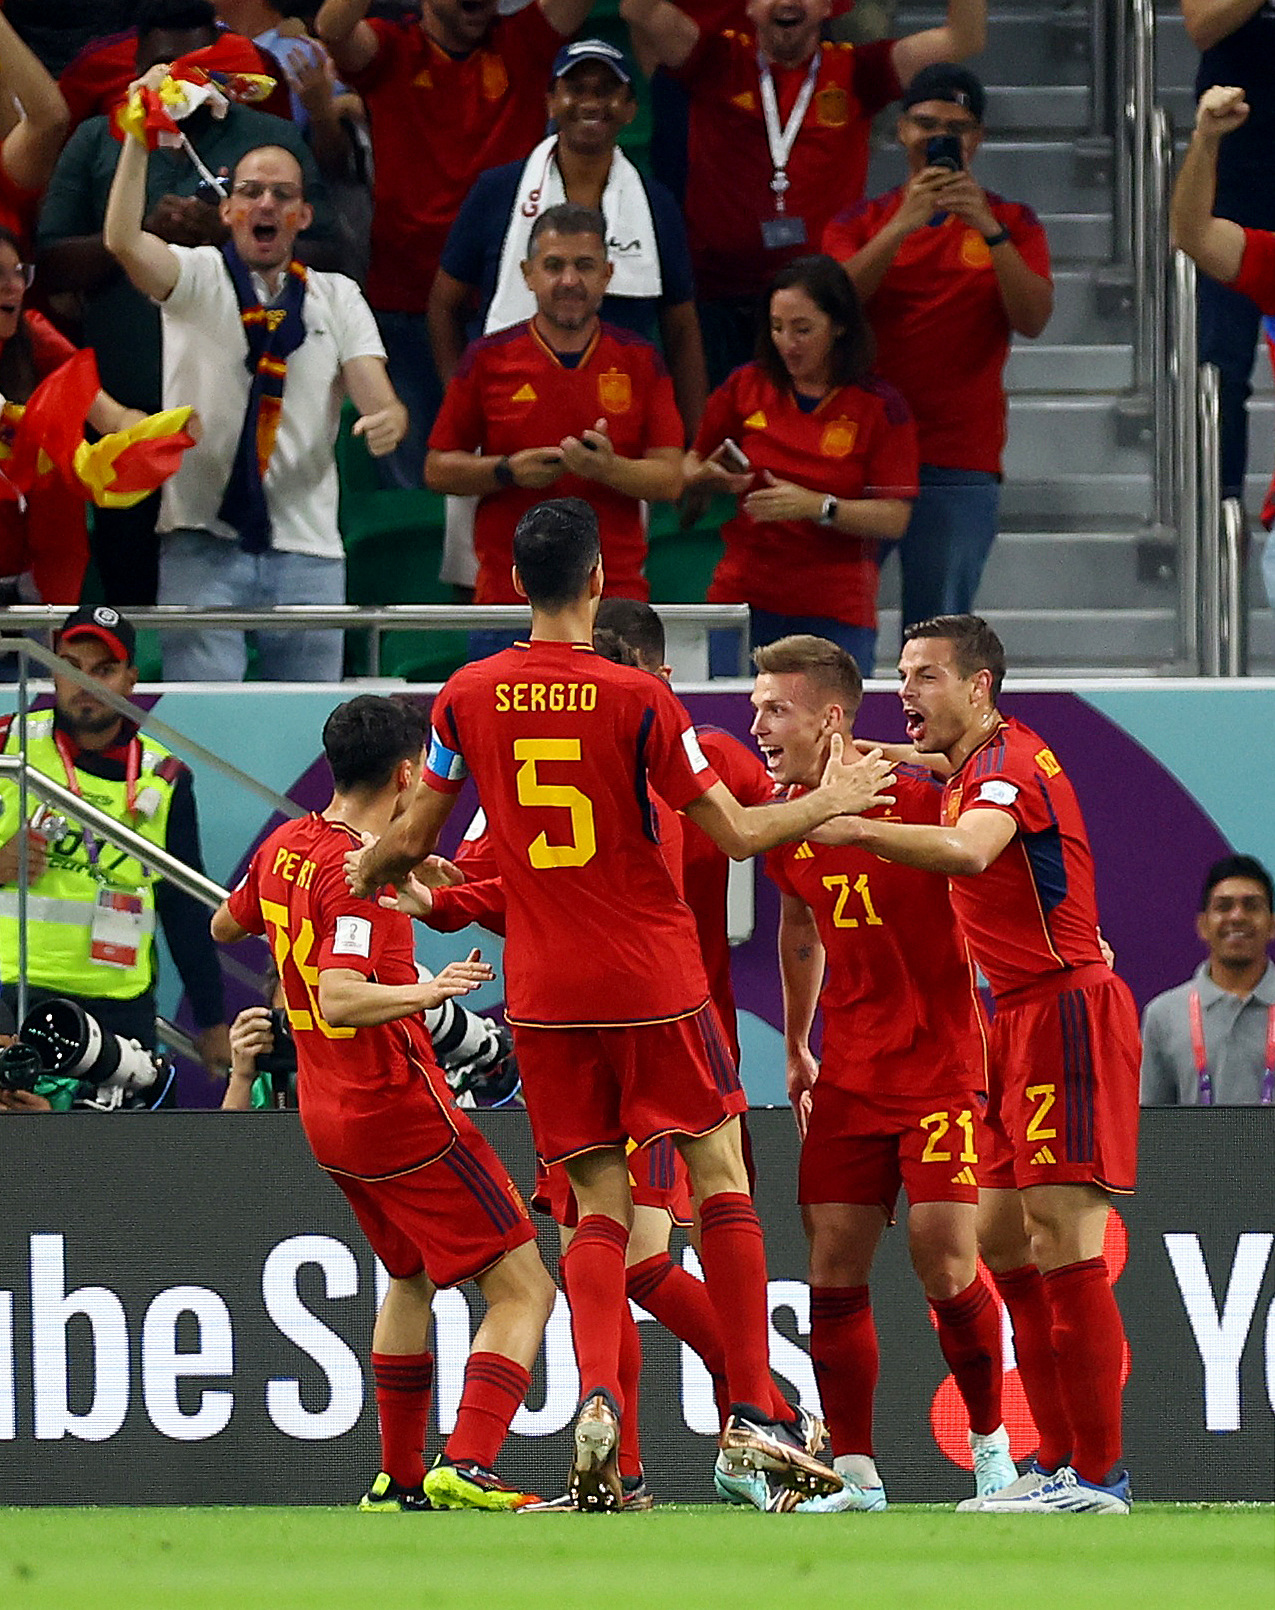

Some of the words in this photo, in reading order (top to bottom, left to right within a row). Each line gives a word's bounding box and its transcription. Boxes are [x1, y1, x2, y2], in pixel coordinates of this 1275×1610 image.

[495, 683, 597, 711] SERGIO
[513, 738, 597, 869] 5
[822, 874, 883, 928] 21
[920, 1110, 978, 1164] 21
[1026, 1084, 1057, 1141] 2
[1162, 1232, 1275, 1430] Y
